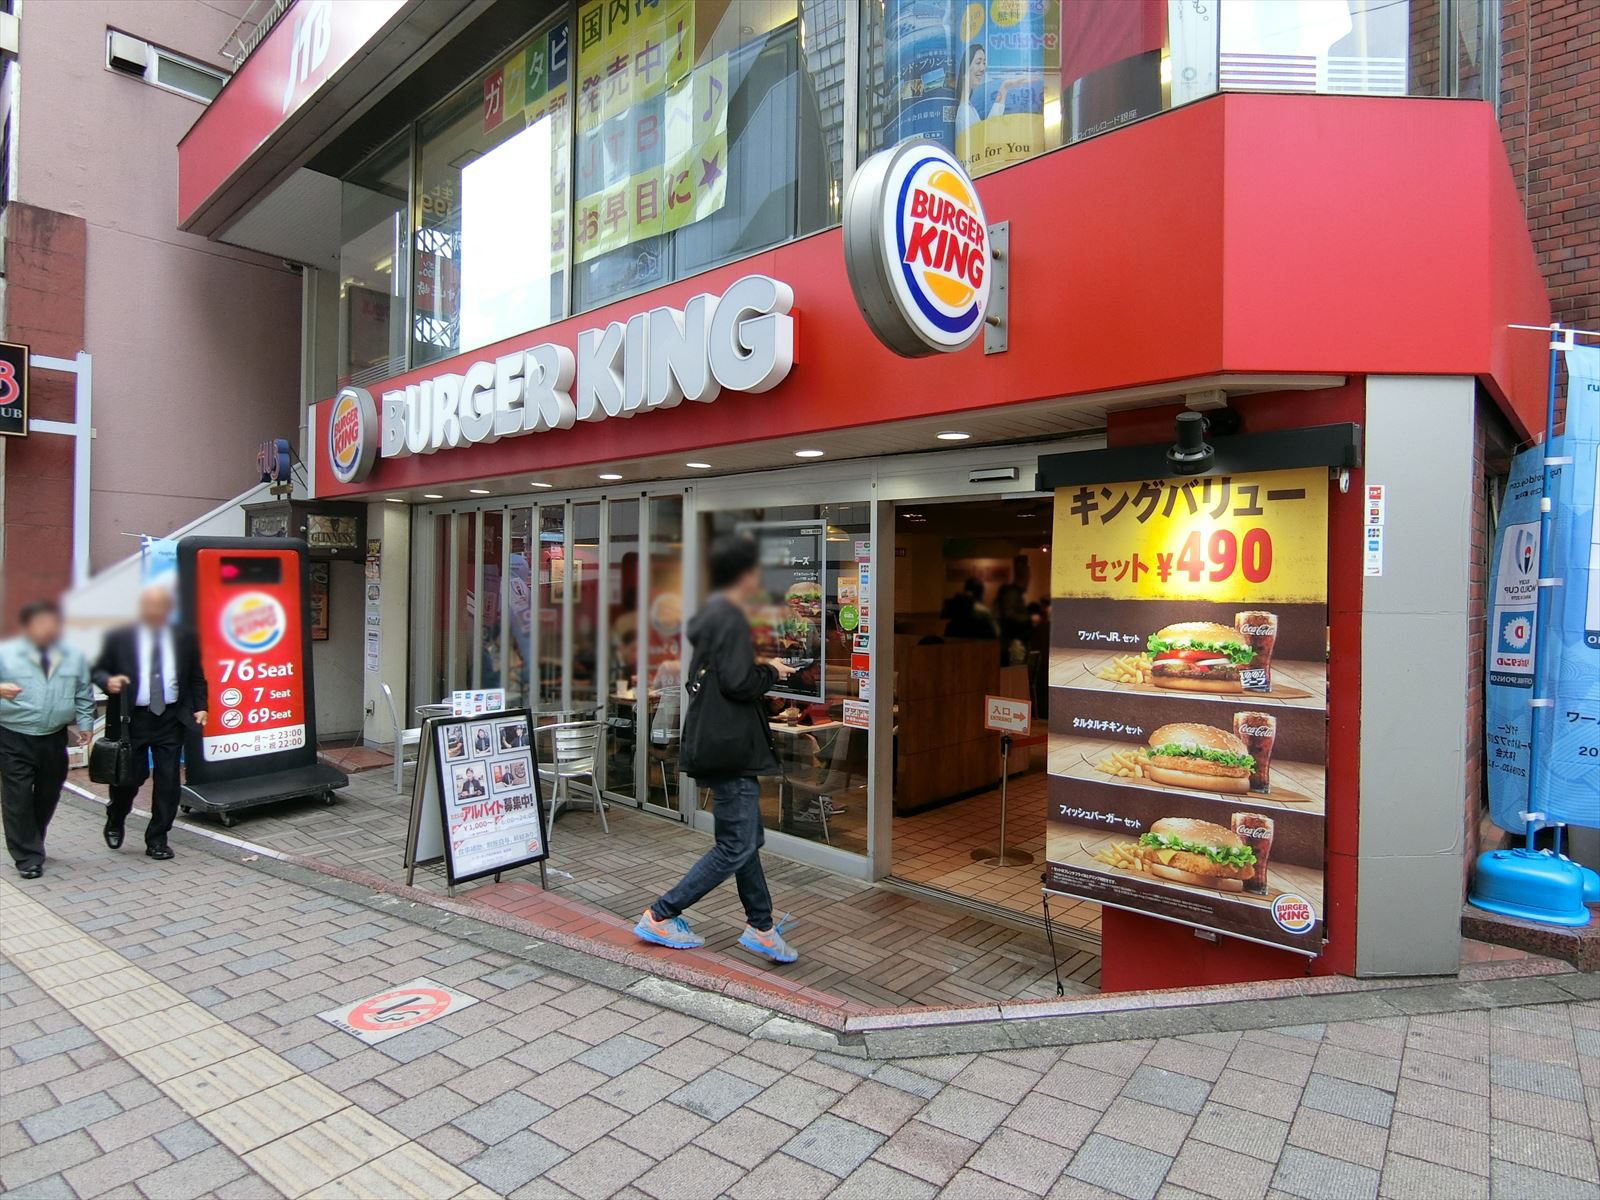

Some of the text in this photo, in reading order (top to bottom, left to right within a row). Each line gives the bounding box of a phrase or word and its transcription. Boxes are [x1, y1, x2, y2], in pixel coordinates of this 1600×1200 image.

[985, 147, 1002, 158] for
[1006, 142, 1030, 153] You
[911, 188, 984, 251] BURGER
[905, 222, 985, 289] KING
[381, 274, 794, 459] BURGER KING
[334, 407, 358, 438] BURGER
[334, 421, 358, 456] KING
[1071, 477, 1306, 526] キングバリュー
[311, 532, 354, 544] GUINNESS
[1086, 528, 1273, 584] セット ¥490
[1122, 634, 1140, 644] セット
[218, 658, 294, 684] 76 Seat
[253, 687, 292, 704] 7 Seat
[247, 707, 292, 724] 69 Seat
[992, 705, 1011, 716] 入口
[1566, 711, 1600, 725] ワー
[278, 728, 303, 740] 23:00
[1073, 717, 1143, 736] タルタルチキン セット
[278, 738, 302, 749] 22:00
[1059, 804, 1141, 829] フィッシュバーガー セット
[1277, 903, 1308, 912] BURGER
[1278, 910, 1309, 922] KING
